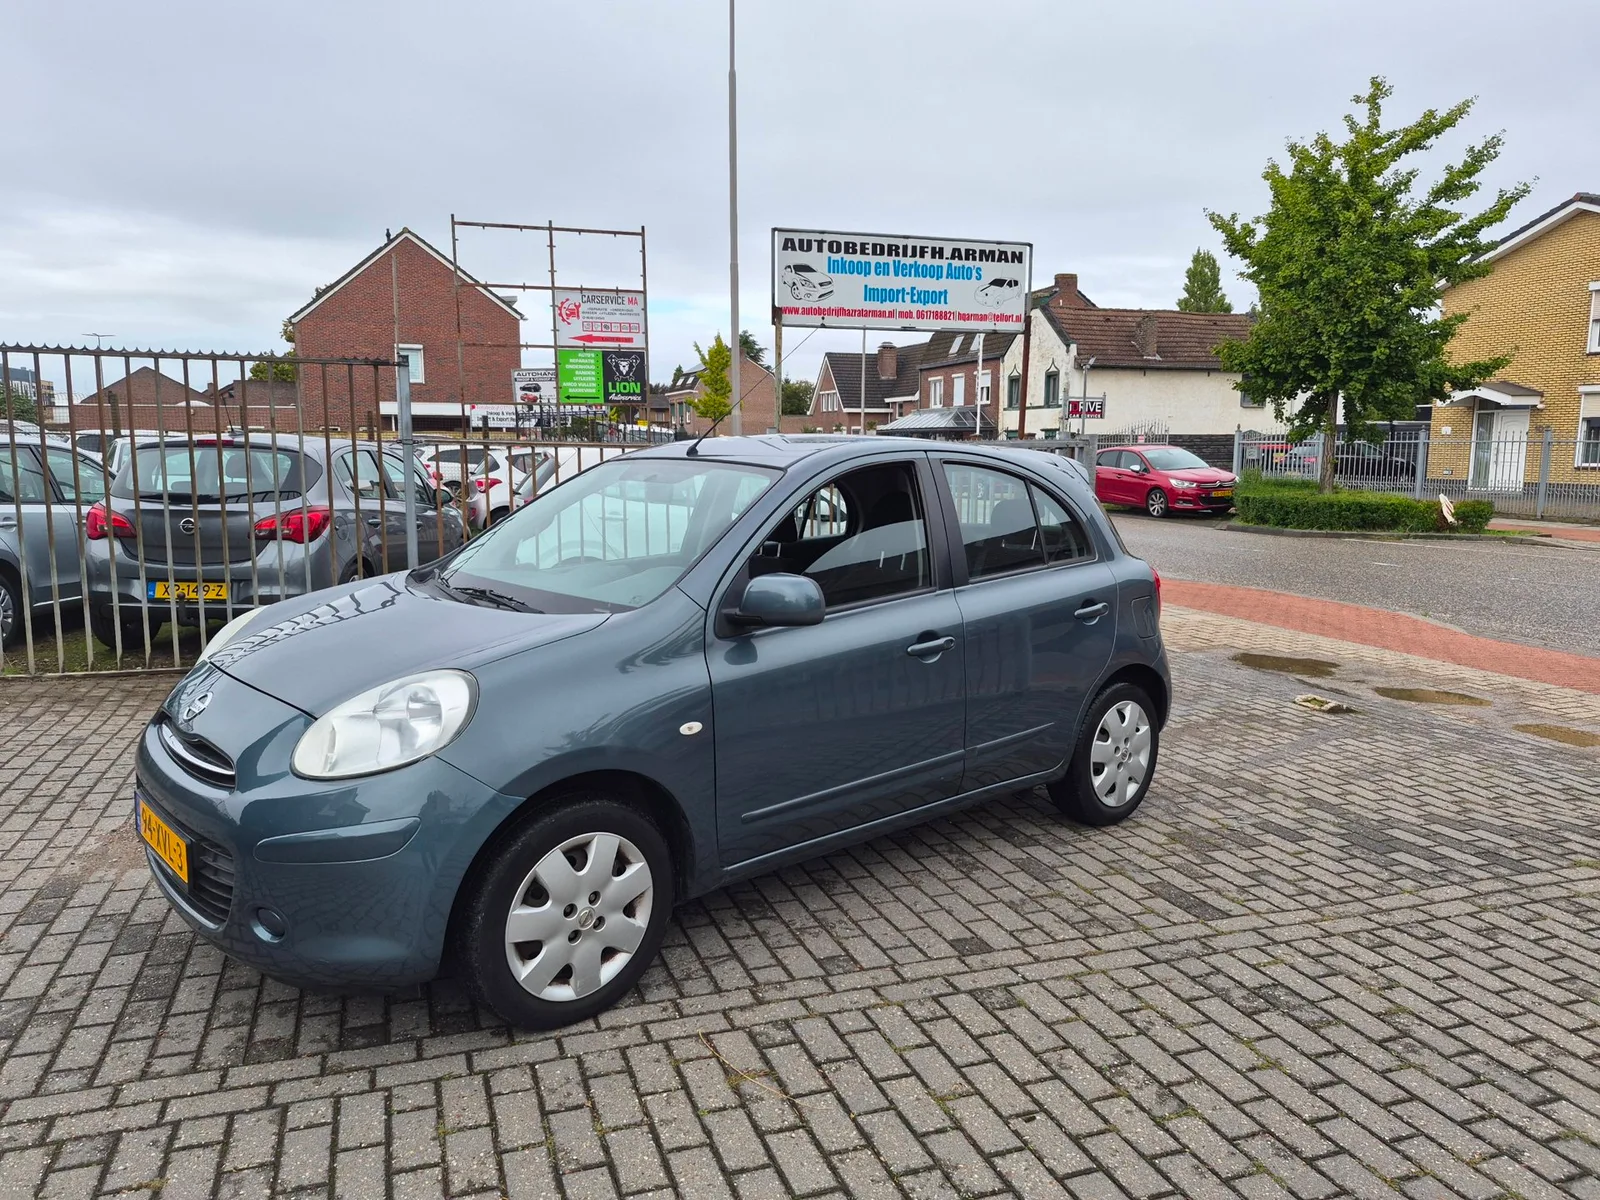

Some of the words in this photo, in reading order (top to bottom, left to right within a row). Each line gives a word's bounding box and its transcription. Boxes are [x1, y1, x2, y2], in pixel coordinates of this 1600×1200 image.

[827, 256, 872, 277] Inkoop
[874, 261, 890, 277] en
[893, 260, 943, 281] Verkoop
[946, 262, 982, 281] Auto's
[581, 294, 626, 306] CARSERVICE
[628, 296, 639, 306] MA
[863, 284, 948, 306] Import-Export
[898, 309, 914, 320] mob.
[916, 309, 955, 320] 0617188821
[608, 382, 641, 394] LION
